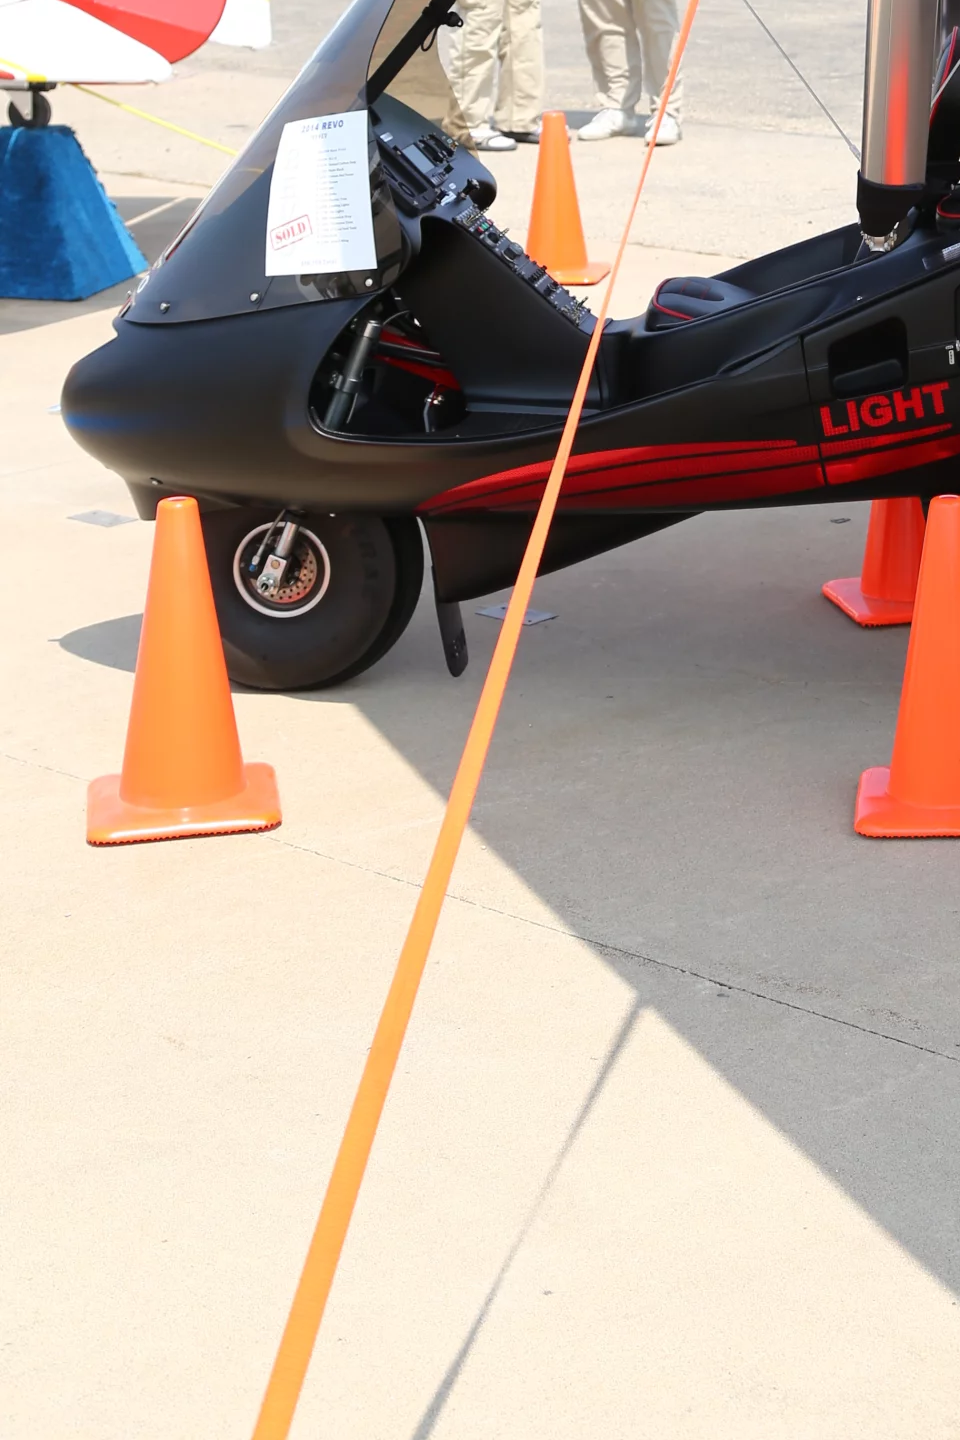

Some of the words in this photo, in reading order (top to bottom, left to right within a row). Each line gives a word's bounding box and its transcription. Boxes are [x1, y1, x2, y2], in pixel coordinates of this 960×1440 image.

[322, 119, 344, 130] REVO
[274, 221, 307, 245] SOLD
[819, 382, 949, 437] LIGHT
